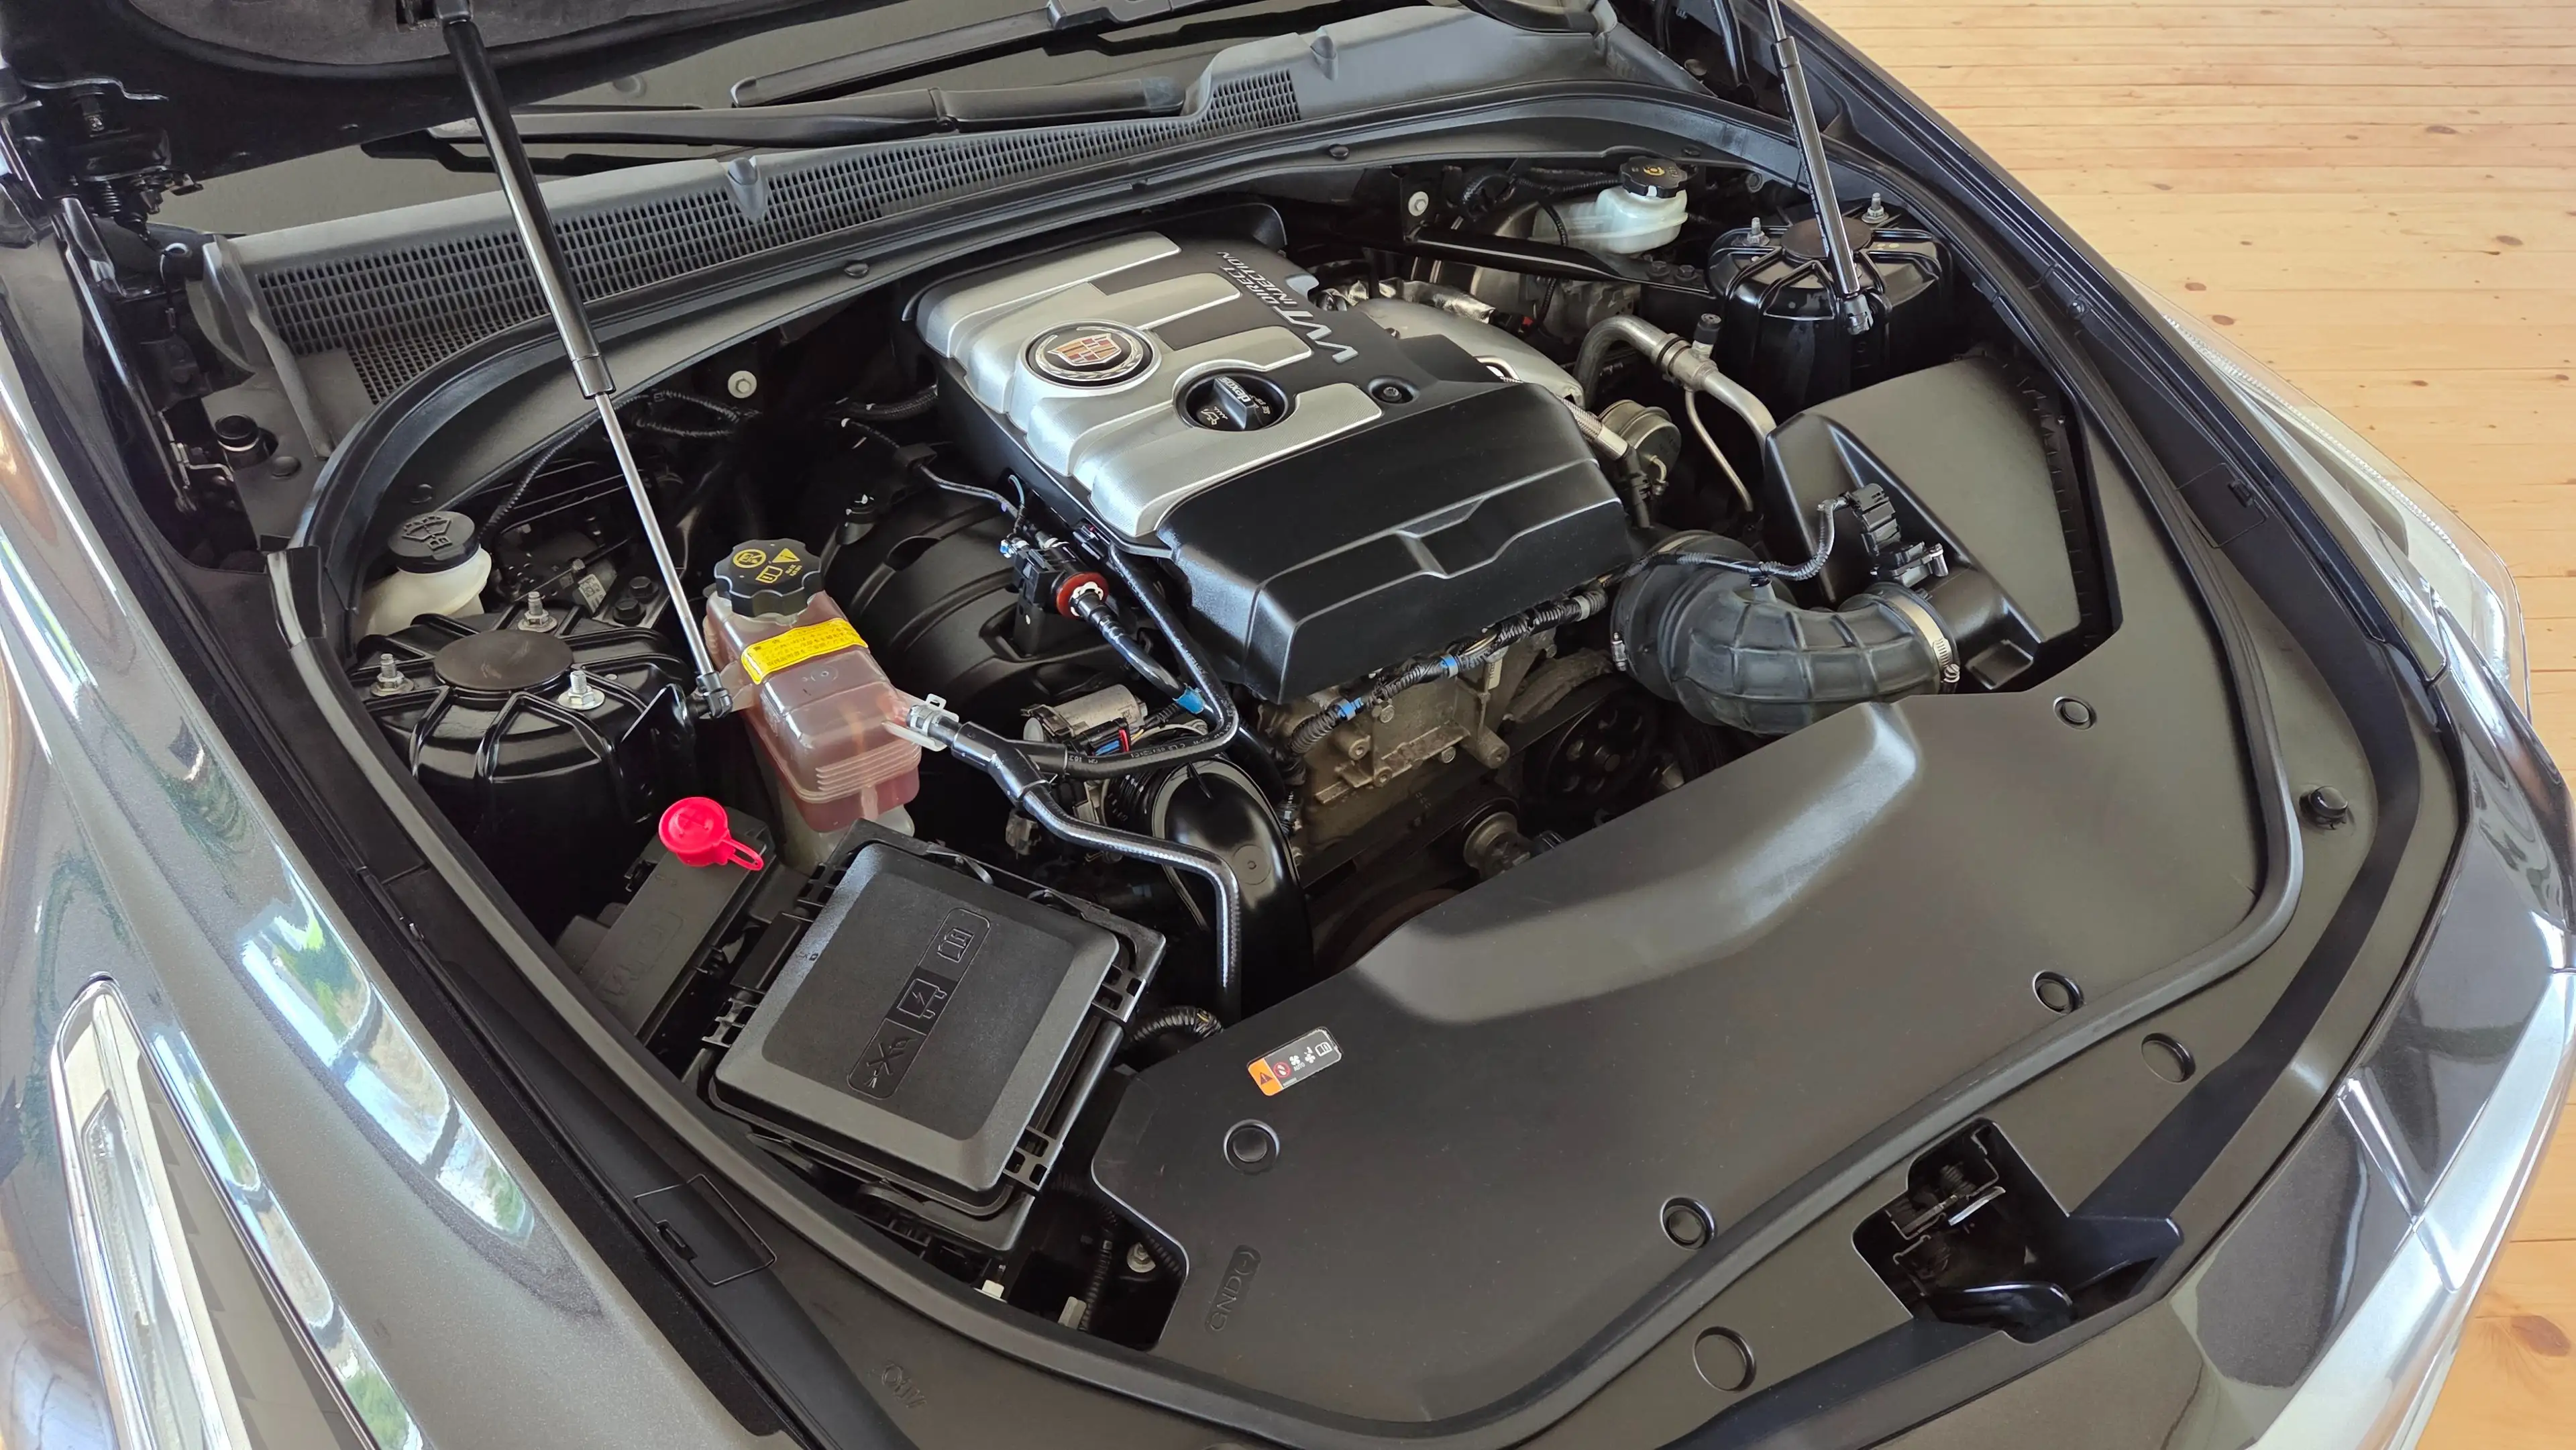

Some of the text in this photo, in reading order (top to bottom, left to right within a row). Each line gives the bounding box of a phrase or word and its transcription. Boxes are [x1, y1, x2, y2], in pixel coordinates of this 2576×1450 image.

[1217, 251, 1298, 305] INJECTION
[1219, 266, 1279, 307] DIRECT
[1273, 305, 1358, 364] VVT
[1221, 376, 1252, 404] dexos
[1293, 1062, 1305, 1072] AUTO
